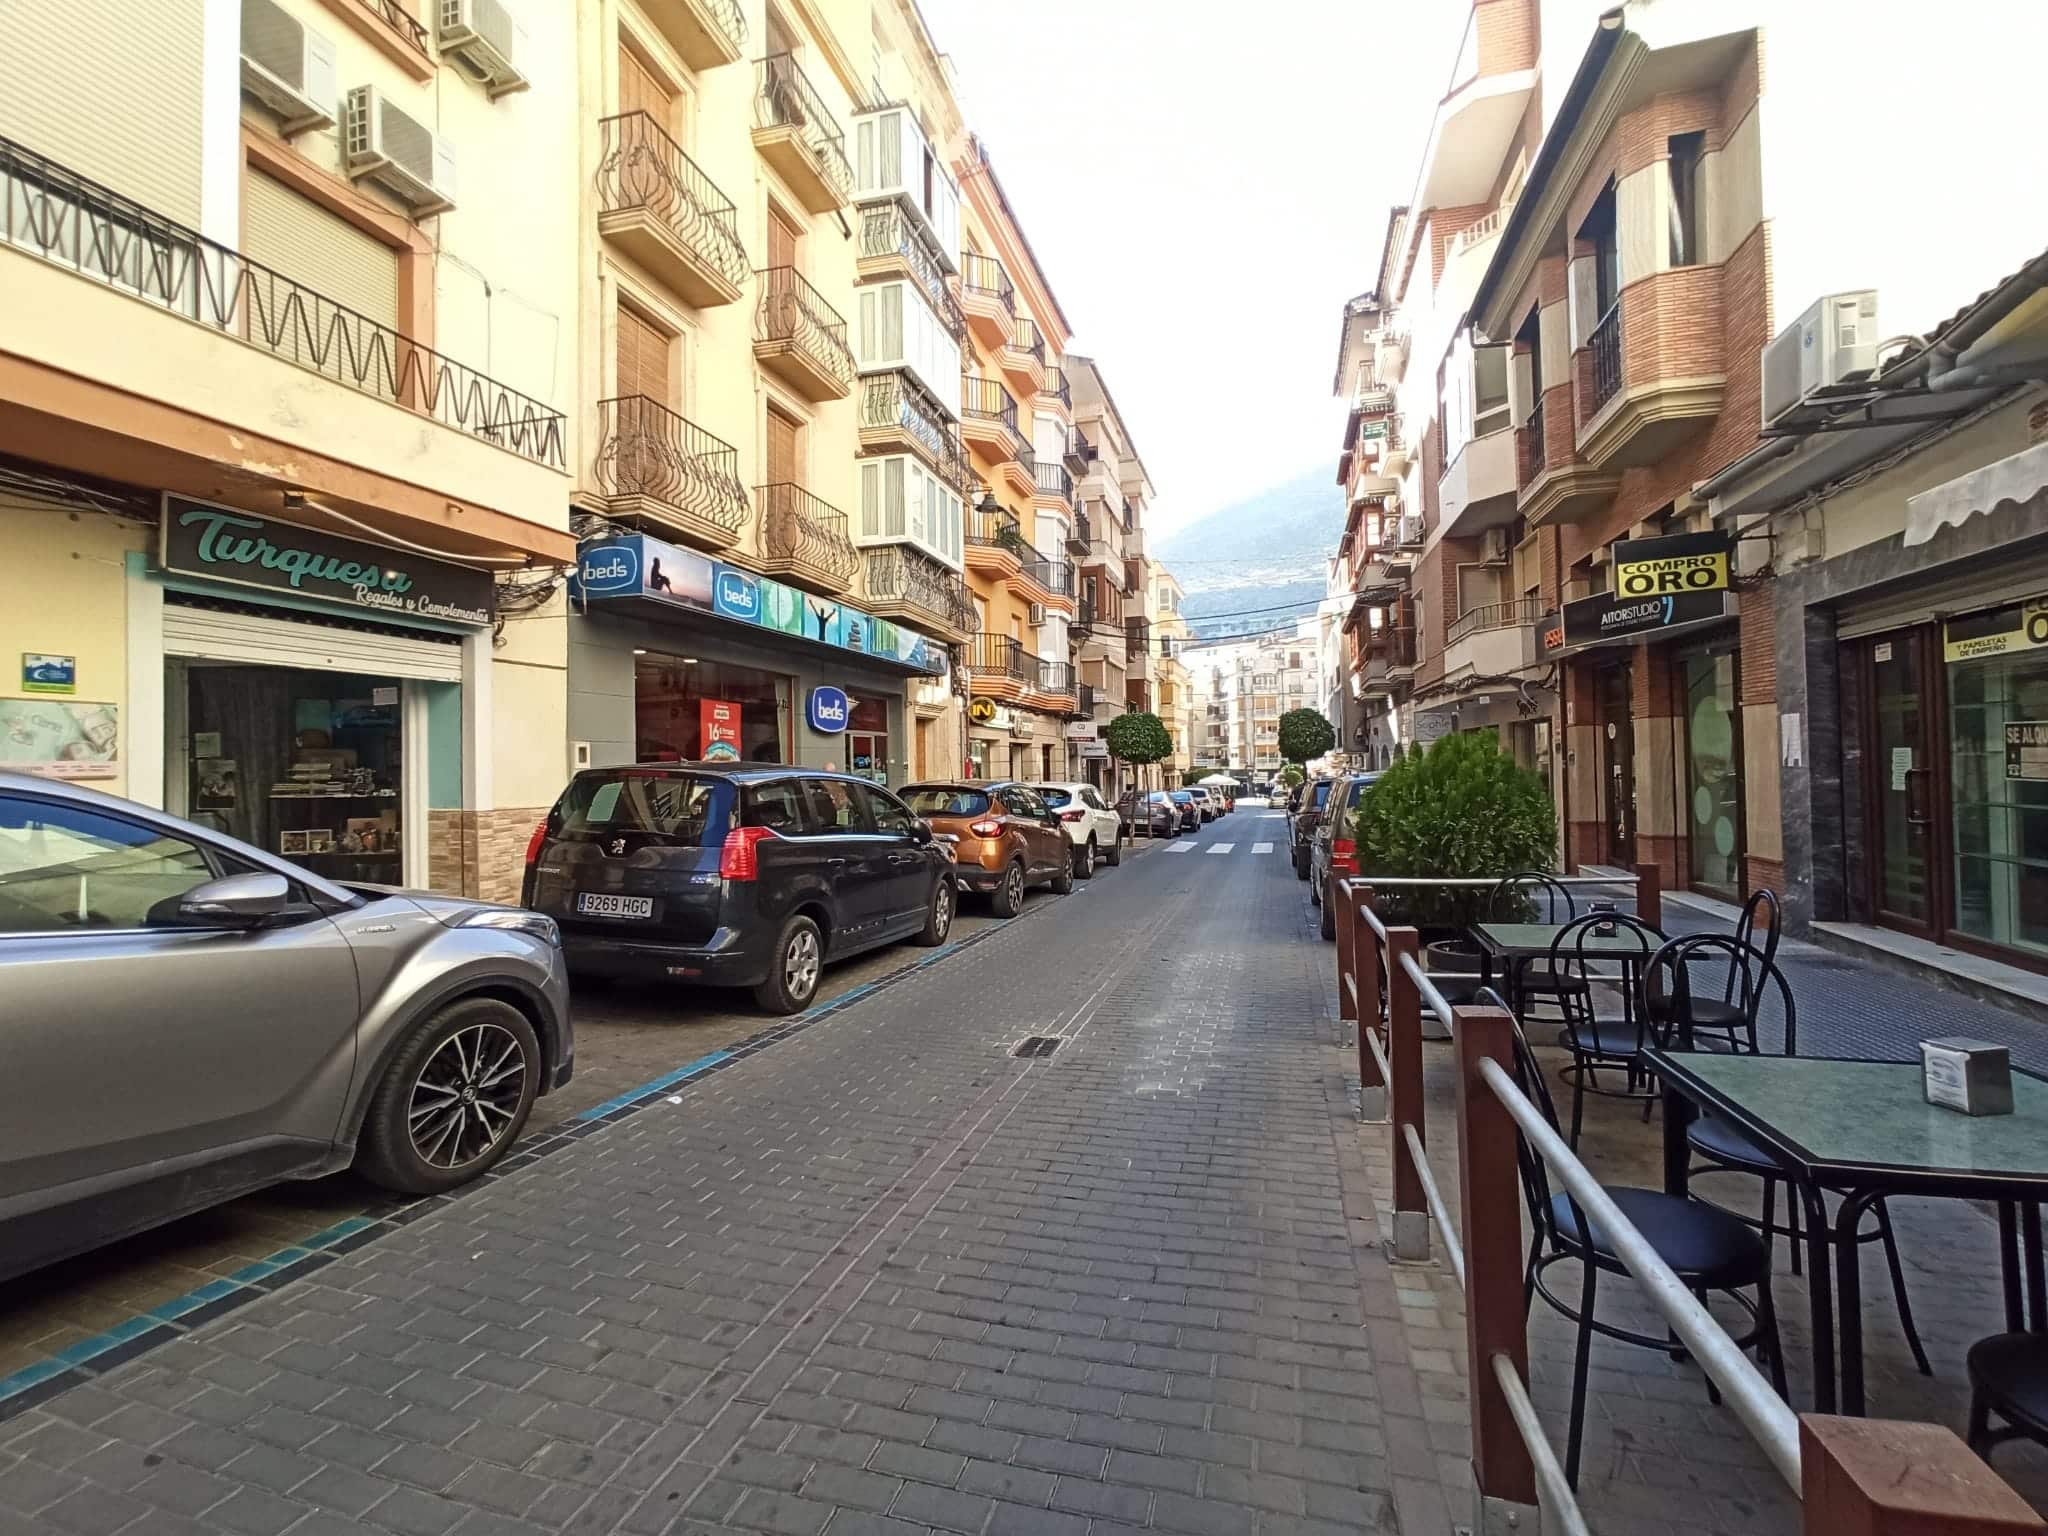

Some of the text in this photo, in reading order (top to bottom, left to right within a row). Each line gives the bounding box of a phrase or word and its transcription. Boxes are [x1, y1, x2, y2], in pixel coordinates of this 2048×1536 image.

[179, 511, 412, 593] Turquesa
[585, 557, 628, 580] bed's
[1623, 556, 1716, 575] COMPRO
[1624, 567, 1717, 594] ORO
[353, 583, 489, 622] Regalos y Complementos
[724, 581, 752, 608] bed's
[1601, 601, 1661, 625] AITORSTUDIO
[1963, 636, 2007, 649] PAPELETAS
[818, 697, 844, 721] bed's
[708, 722, 719, 741] 16
[2007, 727, 2020, 744] SE
[586, 896, 649, 914] 9269 HGC
